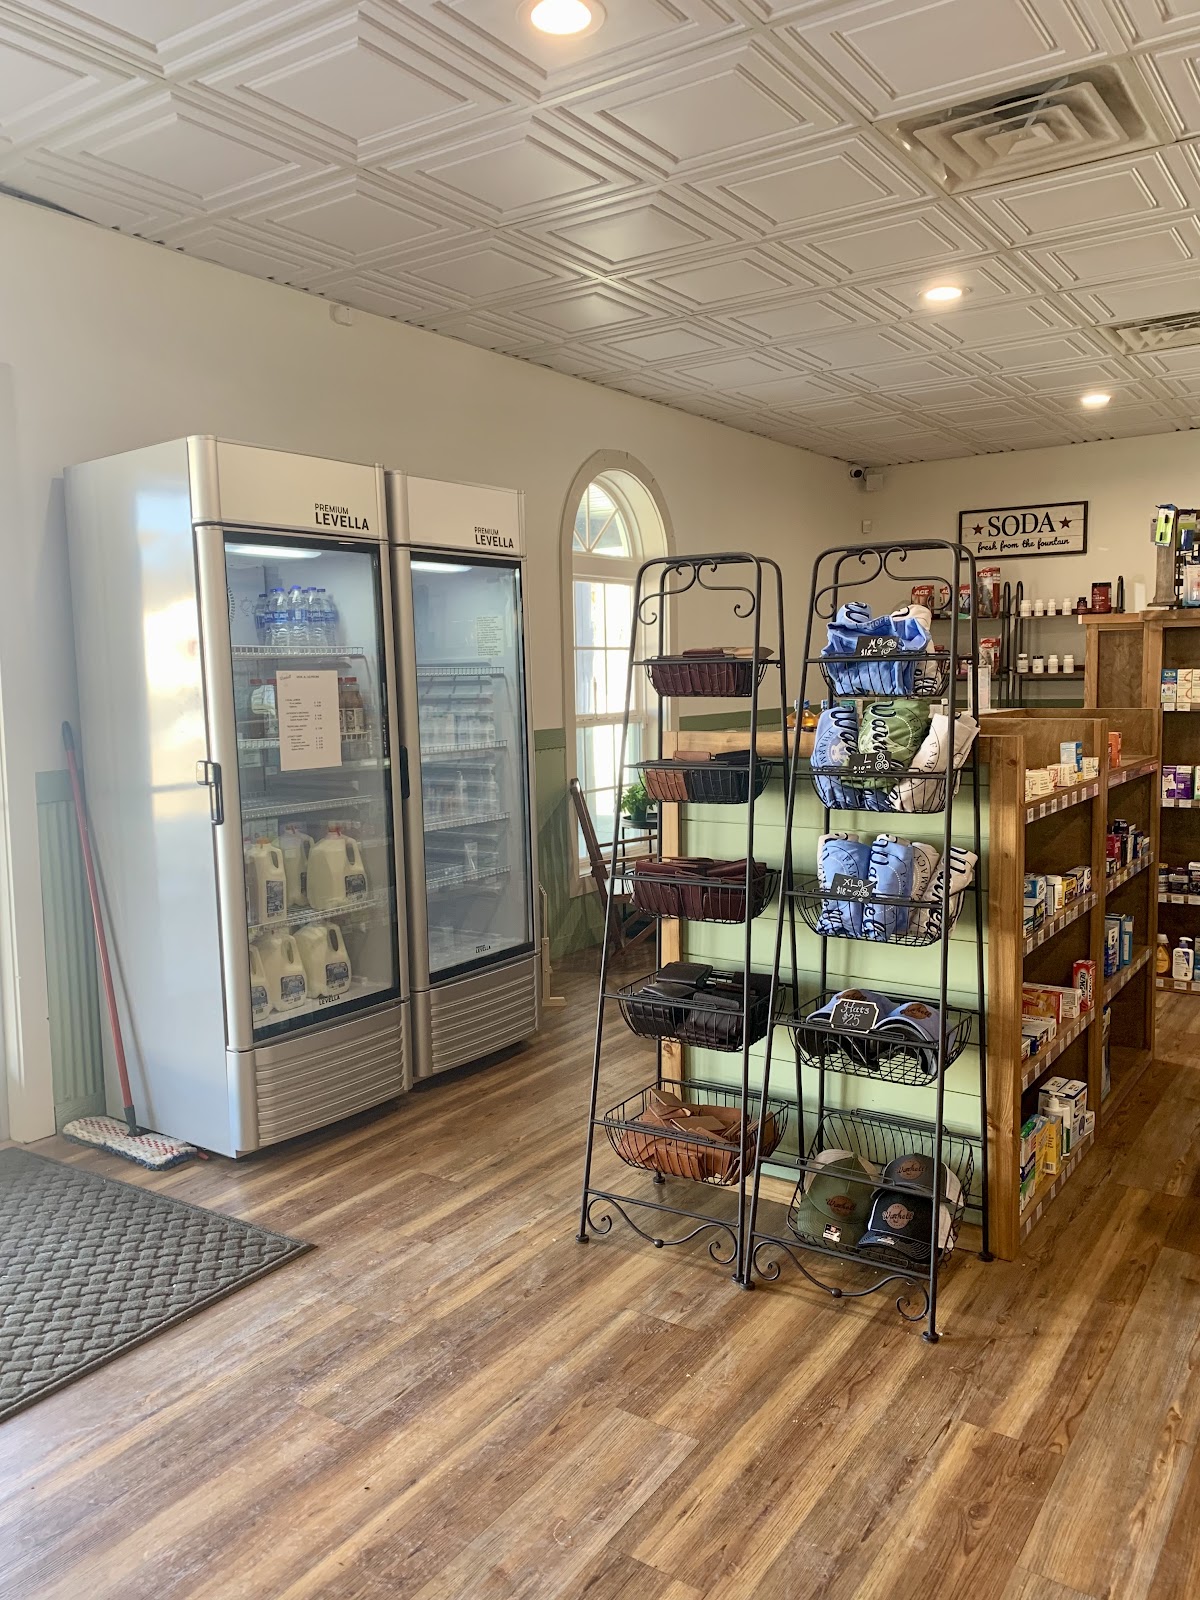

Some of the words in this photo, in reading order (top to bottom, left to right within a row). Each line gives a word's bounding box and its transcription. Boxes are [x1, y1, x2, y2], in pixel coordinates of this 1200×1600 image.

[314, 503, 349, 515] PREMIUM
[315, 512, 370, 530] LEVELLA
[988, 512, 1056, 537] SODA
[474, 526, 499, 535] PREMIUM
[475, 534, 514, 548] LEVELLA
[978, 541, 997, 553] fresh
[1000, 541, 1019, 552] from
[1022, 539, 1035, 548] the
[1037, 537, 1069, 549] fountain
[863, 754, 872, 763] L
[843, 878, 858, 887] XL
[840, 1002, 870, 1015] Hats
[842, 1012, 861, 1026] $25
